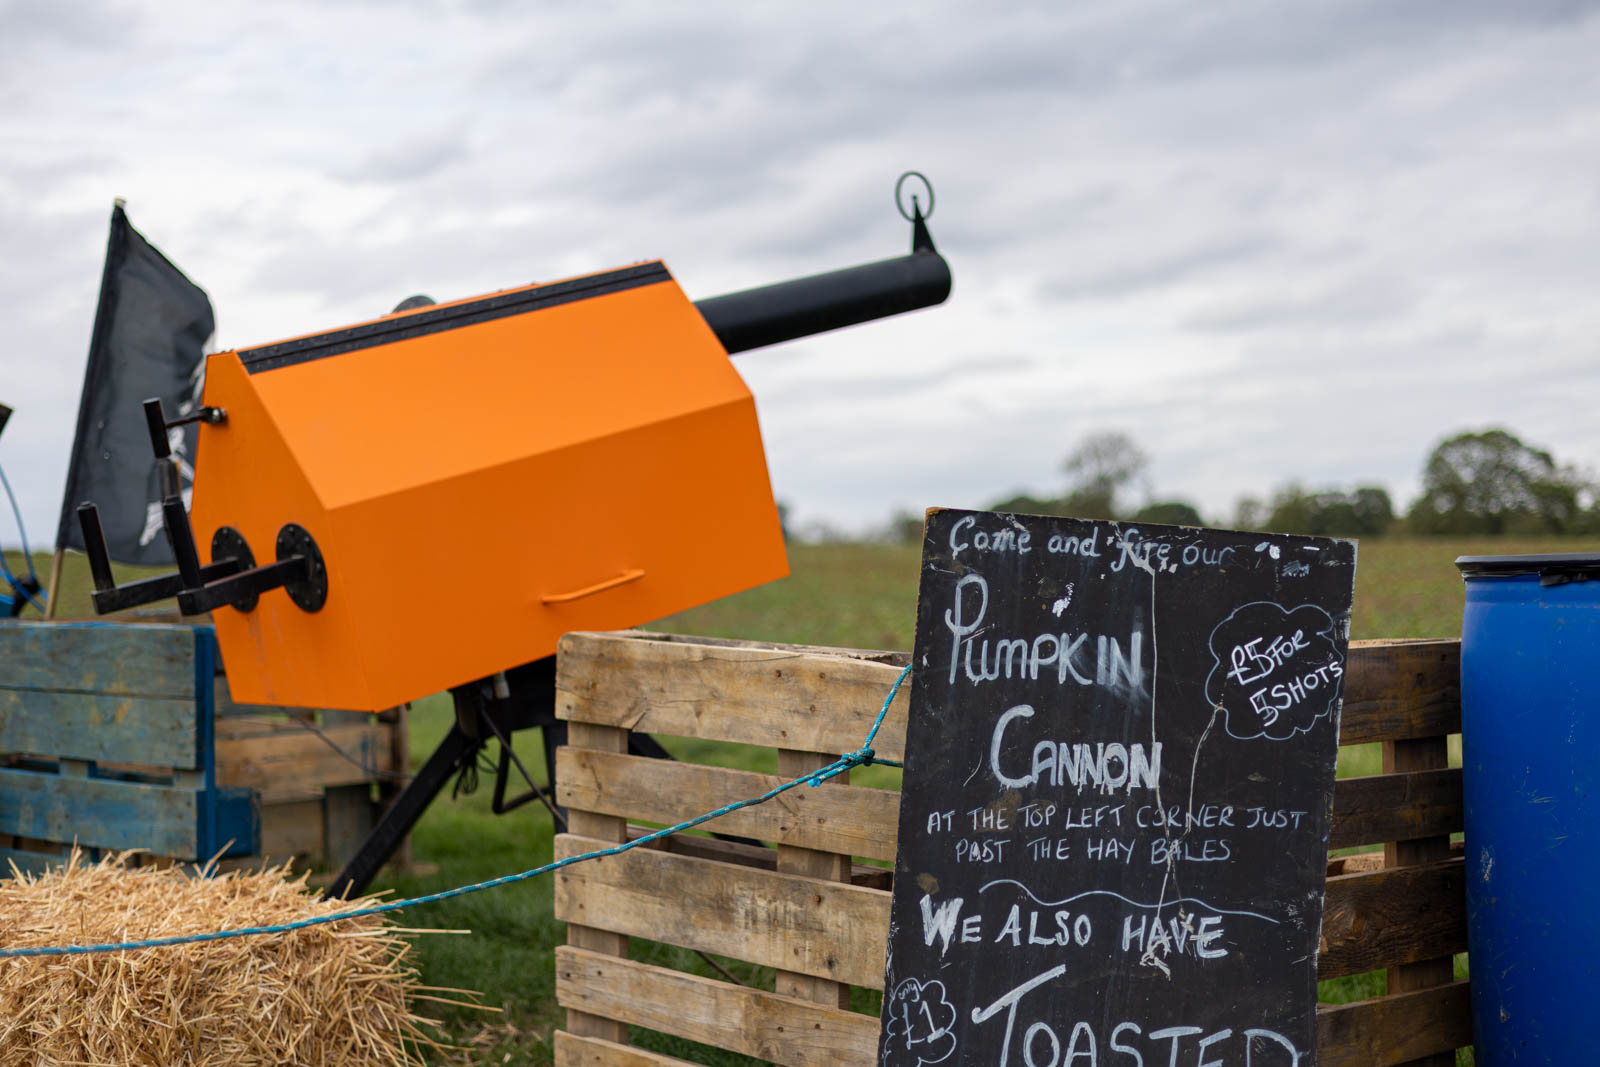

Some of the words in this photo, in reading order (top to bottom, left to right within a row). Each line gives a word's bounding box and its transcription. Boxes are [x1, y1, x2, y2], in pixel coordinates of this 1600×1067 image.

[949, 516, 1031, 558] Come
[1049, 527, 1101, 557] and
[1111, 528, 1171, 572] fire
[1182, 544, 1235, 566] our
[991, 704, 1162, 791] CANNON
[927, 810, 955, 834] AT
[967, 806, 1009, 830] THE
[1017, 804, 1057, 828] TOP
[1065, 805, 1126, 829] LEFT
[1136, 806, 1237, 828] CORNER
[1246, 808, 1309, 829] JUST
[955, 838, 1011, 863] PAST
[1027, 837, 1070, 863] THE
[1087, 838, 1137, 864] HAY
[1151, 838, 1231, 864] BALES
[920, 895, 983, 957] WE
[995, 903, 1092, 948] ALSO
[1121, 912, 1229, 959] HAVE
